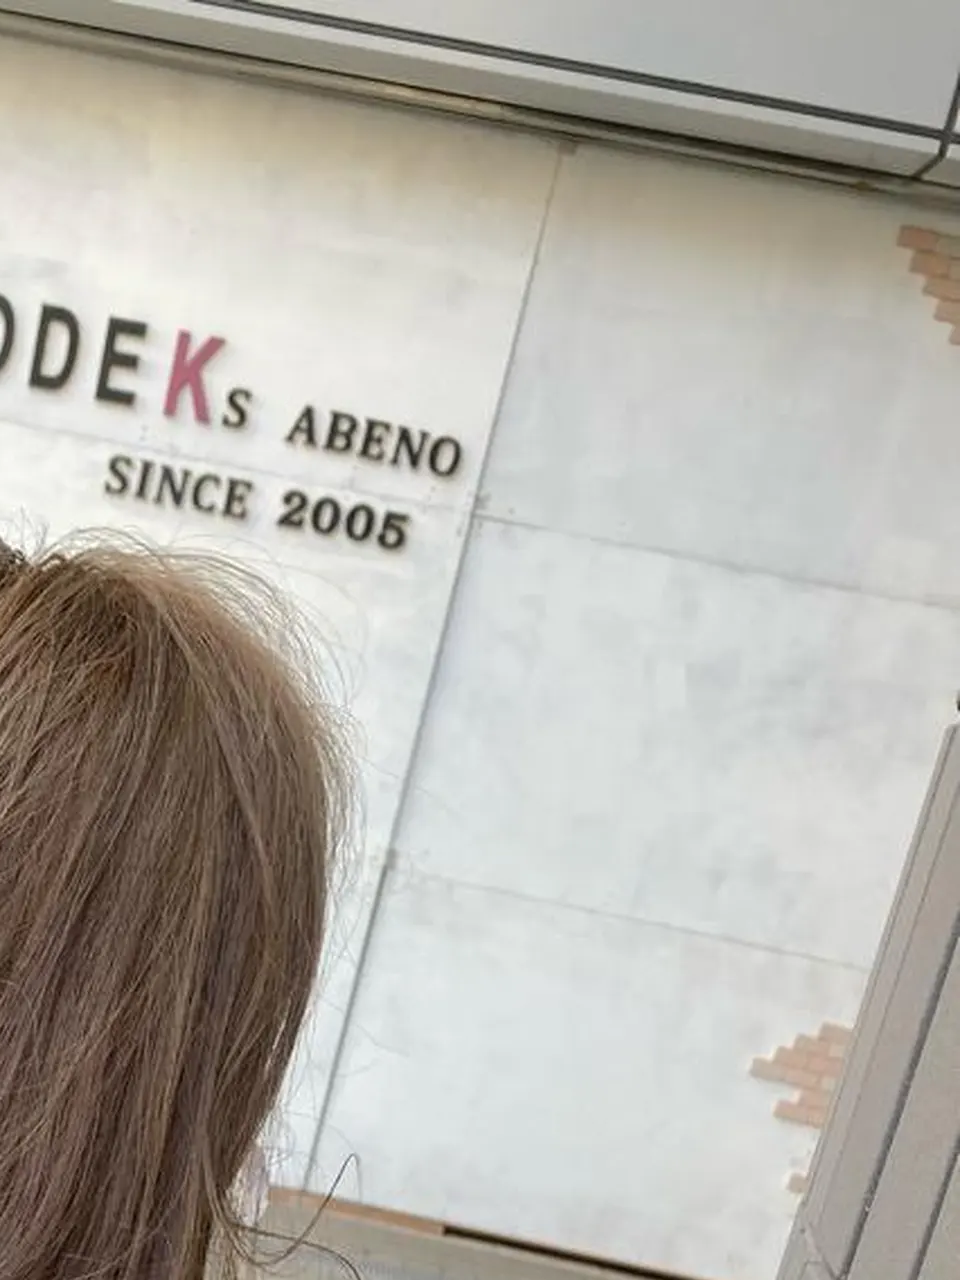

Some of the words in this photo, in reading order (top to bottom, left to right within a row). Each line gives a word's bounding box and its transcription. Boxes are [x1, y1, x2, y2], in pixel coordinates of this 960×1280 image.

[285, 405, 463, 479] ABENO
[104, 455, 254, 521] SINCE
[276, 489, 411, 552] 2005
